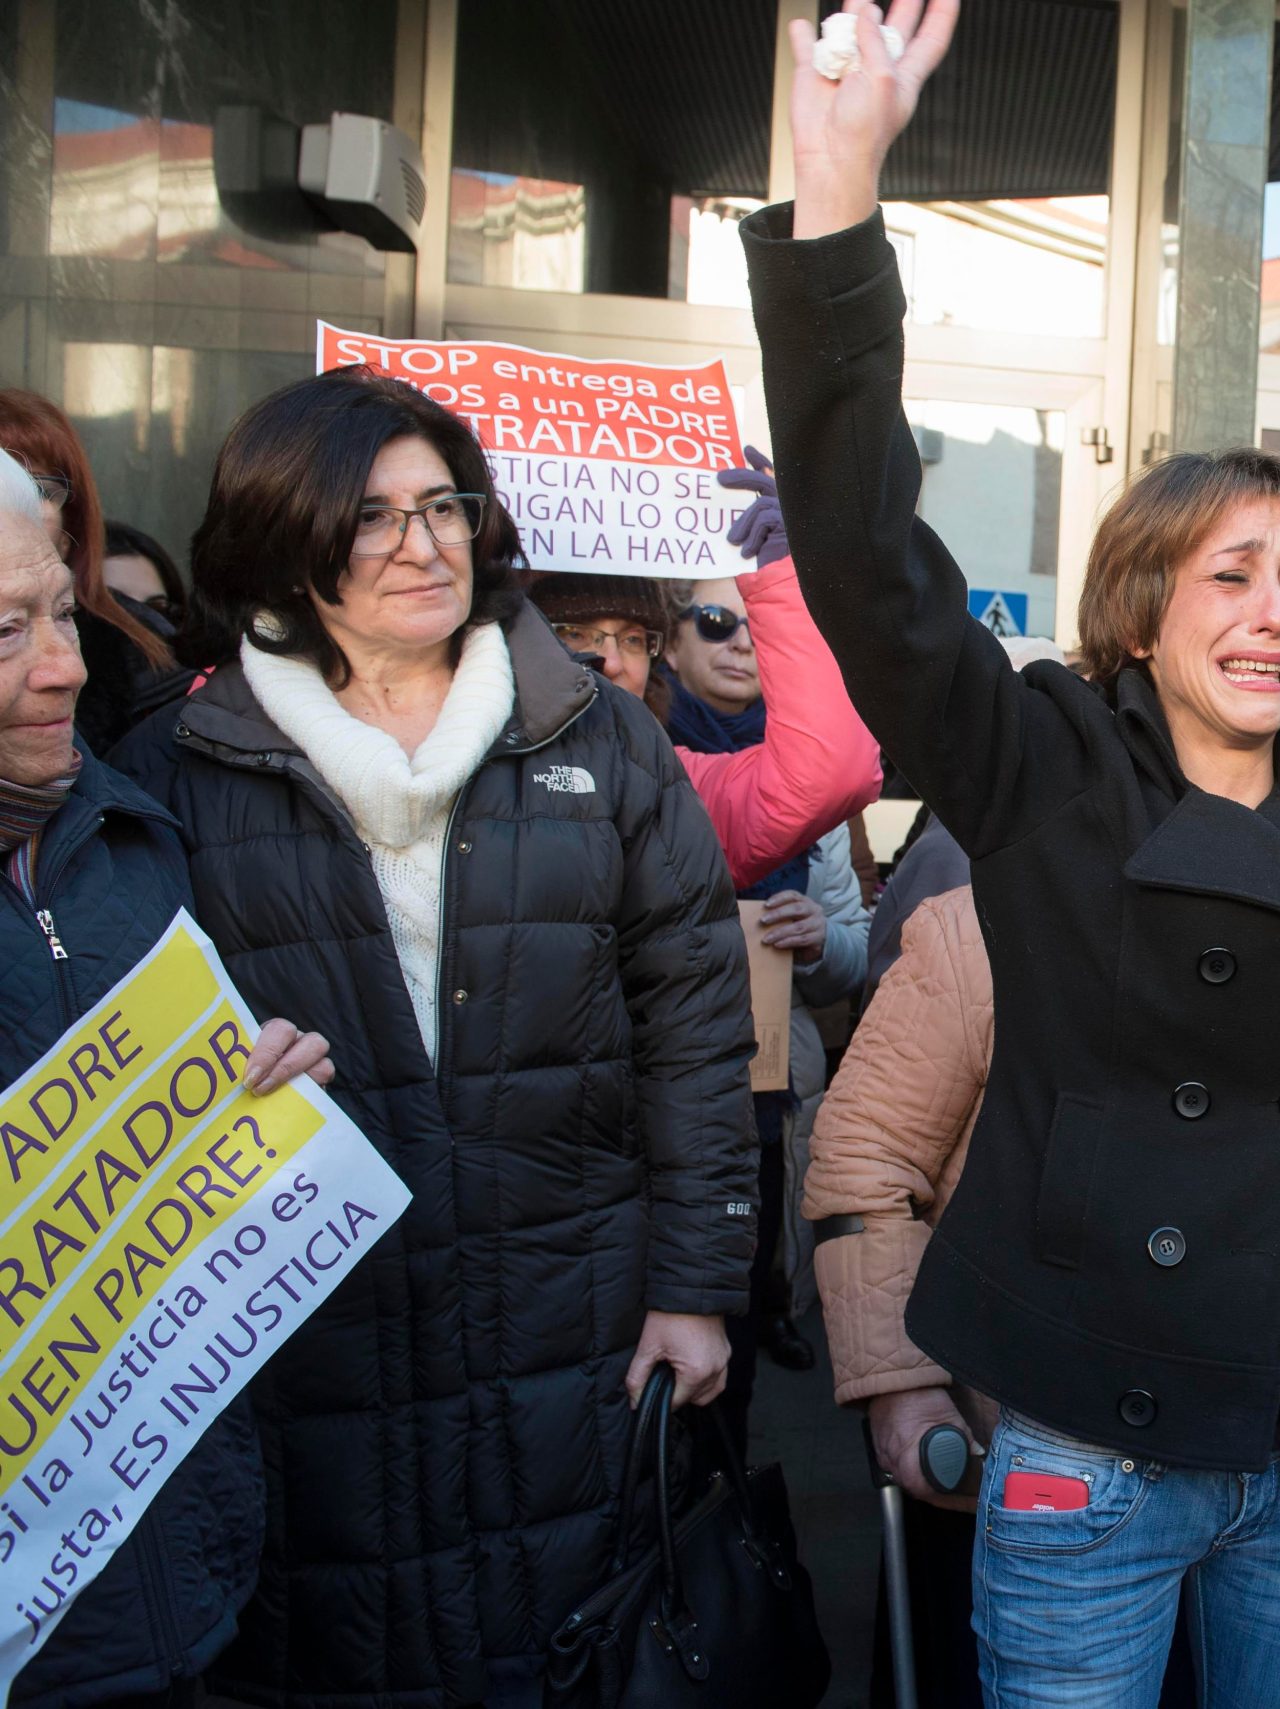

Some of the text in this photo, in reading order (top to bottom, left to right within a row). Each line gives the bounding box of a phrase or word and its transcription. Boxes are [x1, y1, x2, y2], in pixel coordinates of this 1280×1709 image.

[336, 339, 478, 375] STOP
[492, 360, 658, 398] entrega
[669, 378, 721, 404] de
[456, 411, 736, 470] TRATADOR
[498, 392, 731, 441] a un PADRE
[484, 456, 712, 500] STICIA NO SE
[620, 501, 661, 529] LO
[571, 531, 613, 560] LA
[628, 535, 716, 566] HAYA
[533, 774, 573, 783] NORTH
[547, 782, 576, 792] FACE
[549, 765, 572, 775] THE
[0, 1010, 144, 1184] ADRE
[0, 1020, 251, 1328] RATADOR
[0, 1115, 278, 1458] UEN PADRE?
[22, 1457, 74, 1507] la
[70, 1284, 208, 1458] Justicia
[203, 1224, 267, 1285] no
[271, 1172, 319, 1223] es
[15, 1200, 379, 1645] justa, ES INJUSTICIA
